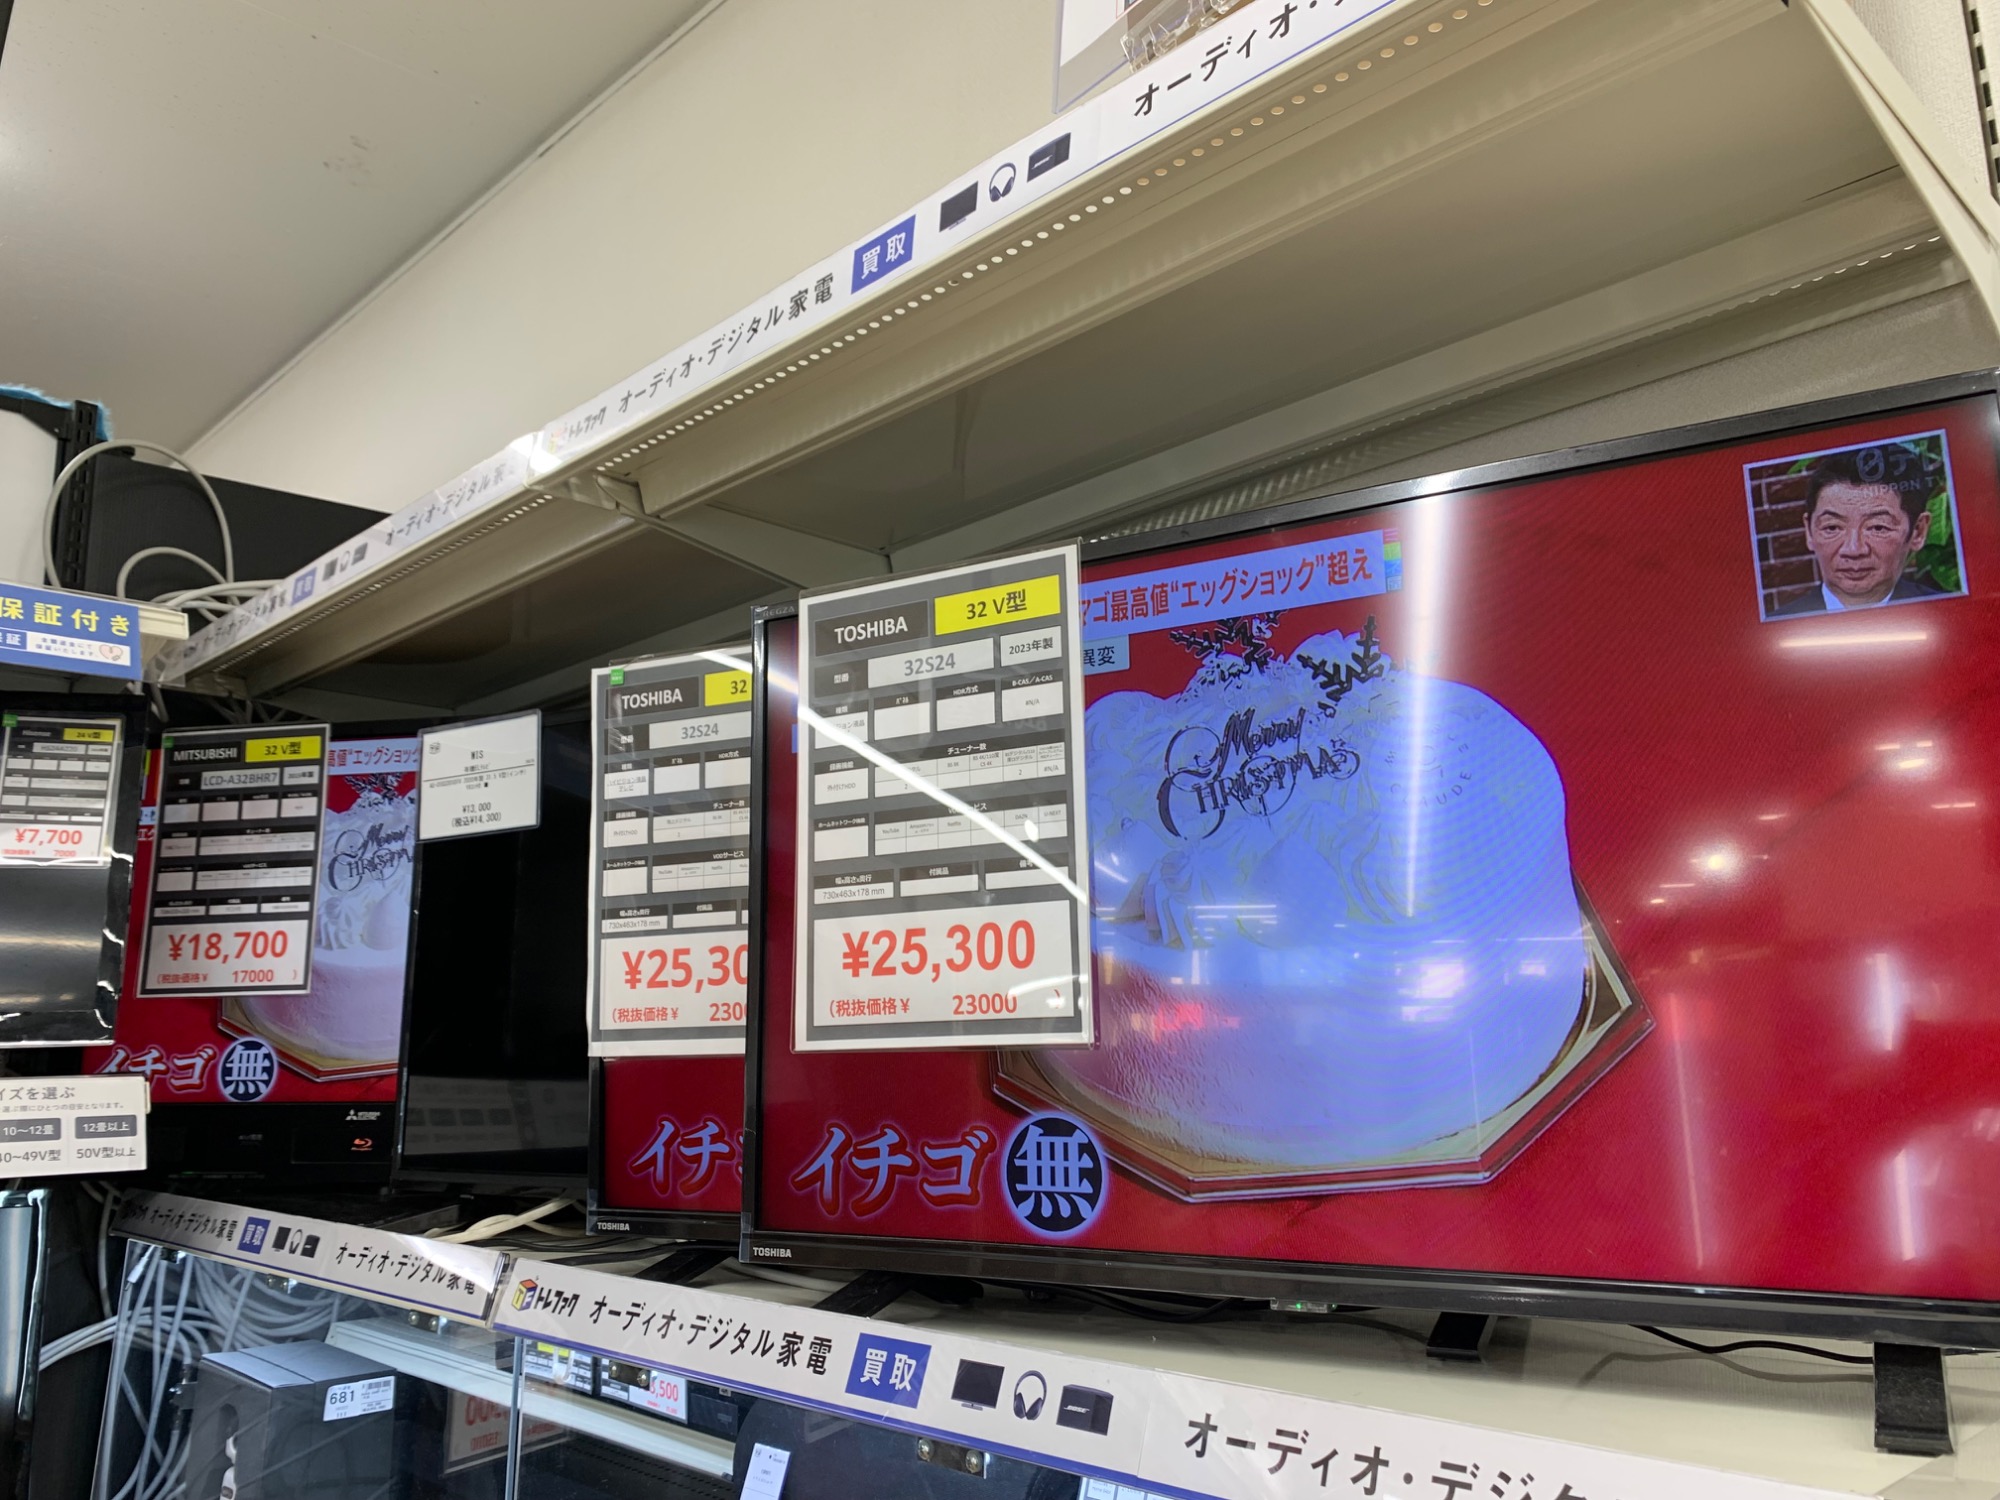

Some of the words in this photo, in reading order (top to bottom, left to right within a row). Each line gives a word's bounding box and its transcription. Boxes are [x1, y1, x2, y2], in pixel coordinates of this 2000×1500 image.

[1134, 0, 1345, 117] オーディオ・
[618, 272, 833, 413] オーディオ・デジタル家電
[861, 231, 906, 280] 買取
[762, 606, 795, 617] REGZA
[834, 616, 908, 644] TOSHIBA
[966, 601, 987, 620] 32
[992, 589, 1027, 614] V型
[904, 652, 956, 677] 32S24
[1009, 637, 1053, 655] 2023年製
[621, 688, 683, 710] TOSHIBA
[730, 679, 747, 695] 32
[681, 722, 719, 740] 32S24
[173, 747, 238, 761] MITSUBISHI
[264, 745, 278, 755] 32
[15, 828, 82, 846] ¥7,700
[871, 887, 885, 897] mm
[168, 930, 288, 964] ¥18,700
[842, 919, 1036, 984] ¥25,300
[232, 969, 274, 984] 17000
[709, 1002, 748, 1022] 230
[952, 993, 1017, 1015] 23000
[224, 1045, 271, 1095] 無
[83, 1122, 130, 1133] 12畳以上
[76, 1147, 136, 1159] 50V型以上
[633, 1120, 742, 1194] イチ
[793, 1126, 990, 1212] イチゴ
[1015, 1126, 1094, 1219] 無
[597, 1222, 630, 1231] TOSHIBA
[753, 1247, 792, 1258] TOSHIBA
[335, 1241, 476, 1295] オーディオ・デジタル家電
[589, 1295, 833, 1376] オーディオ・デジタル家電
[860, 1347, 916, 1393] 買取
[330, 1389, 355, 1405] 681
